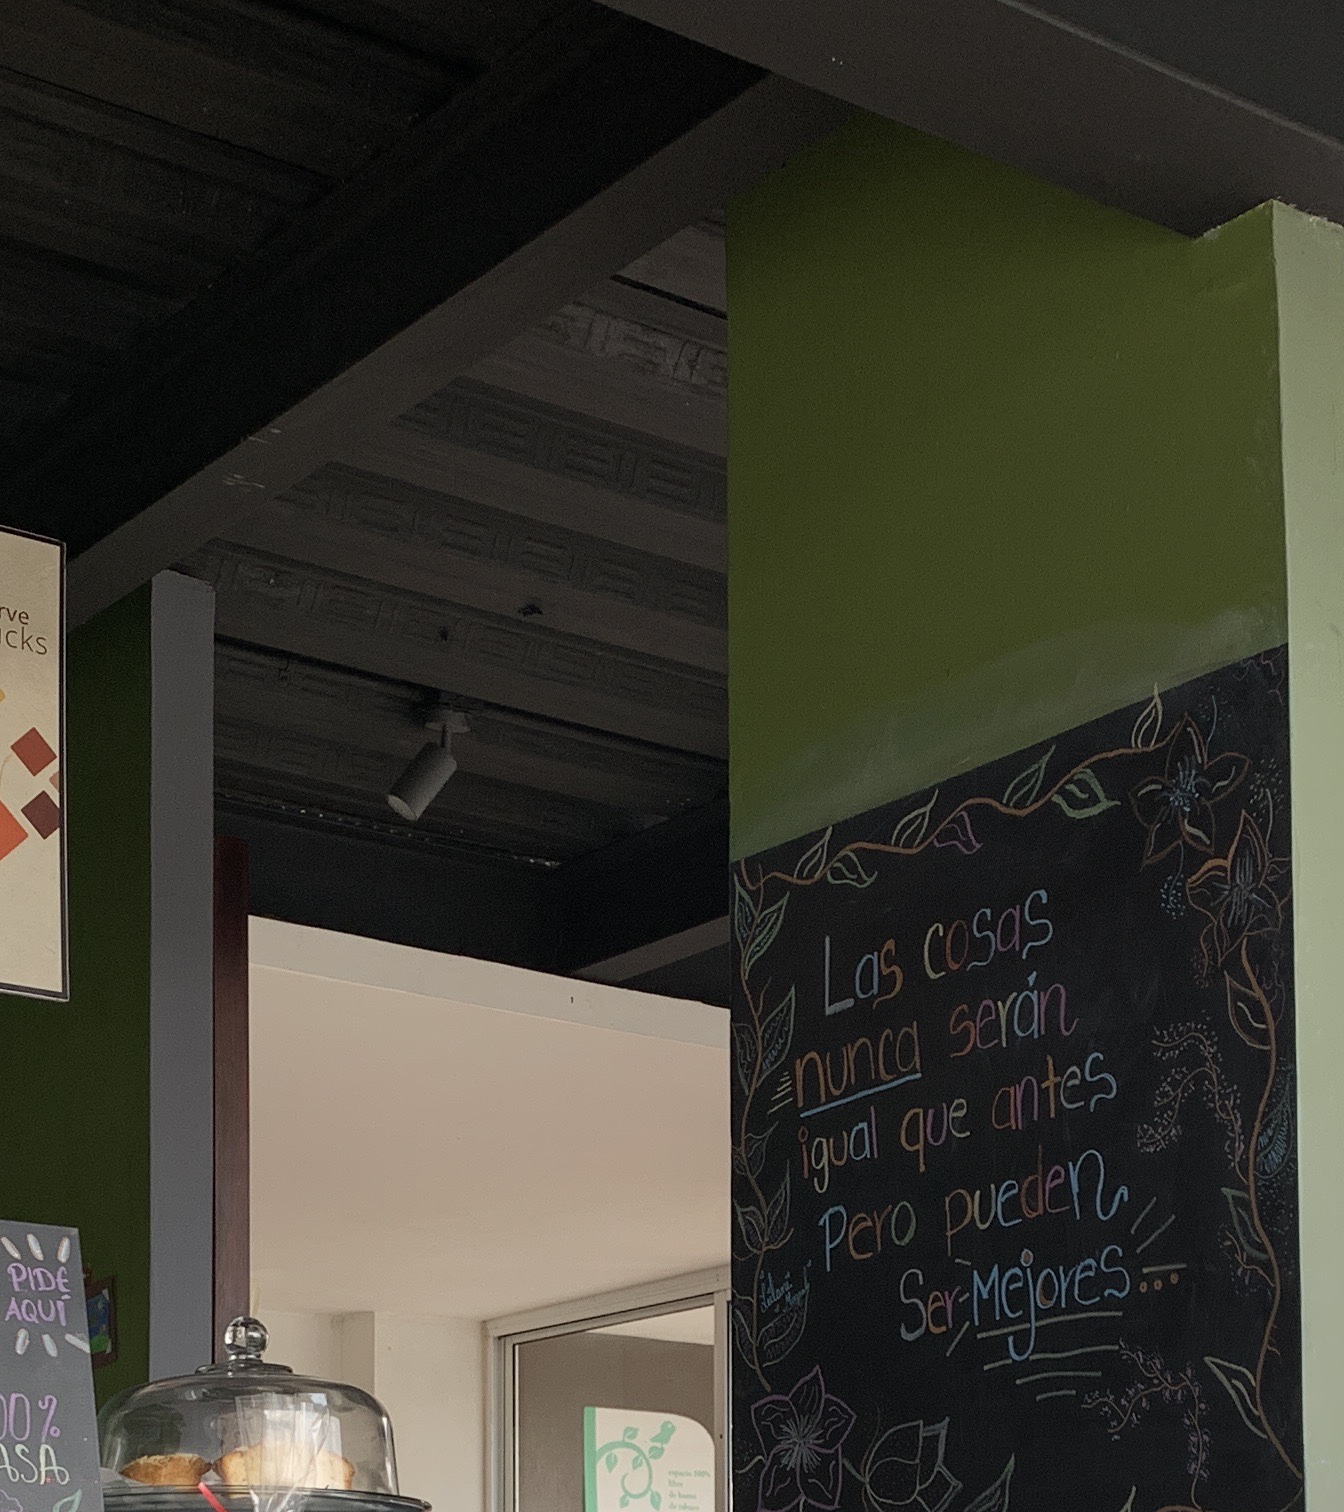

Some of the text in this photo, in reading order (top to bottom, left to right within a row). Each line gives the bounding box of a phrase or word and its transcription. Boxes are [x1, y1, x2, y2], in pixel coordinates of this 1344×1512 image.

[824, 888, 1054, 1016] Las cosas
[794, 971, 1079, 1108] nunca serán
[797, 1051, 1117, 1194] igual que antes
[818, 1148, 1129, 1272] Pero pueden
[7, 1262, 71, 1293] PIDE
[899, 1268, 955, 1342] Ser
